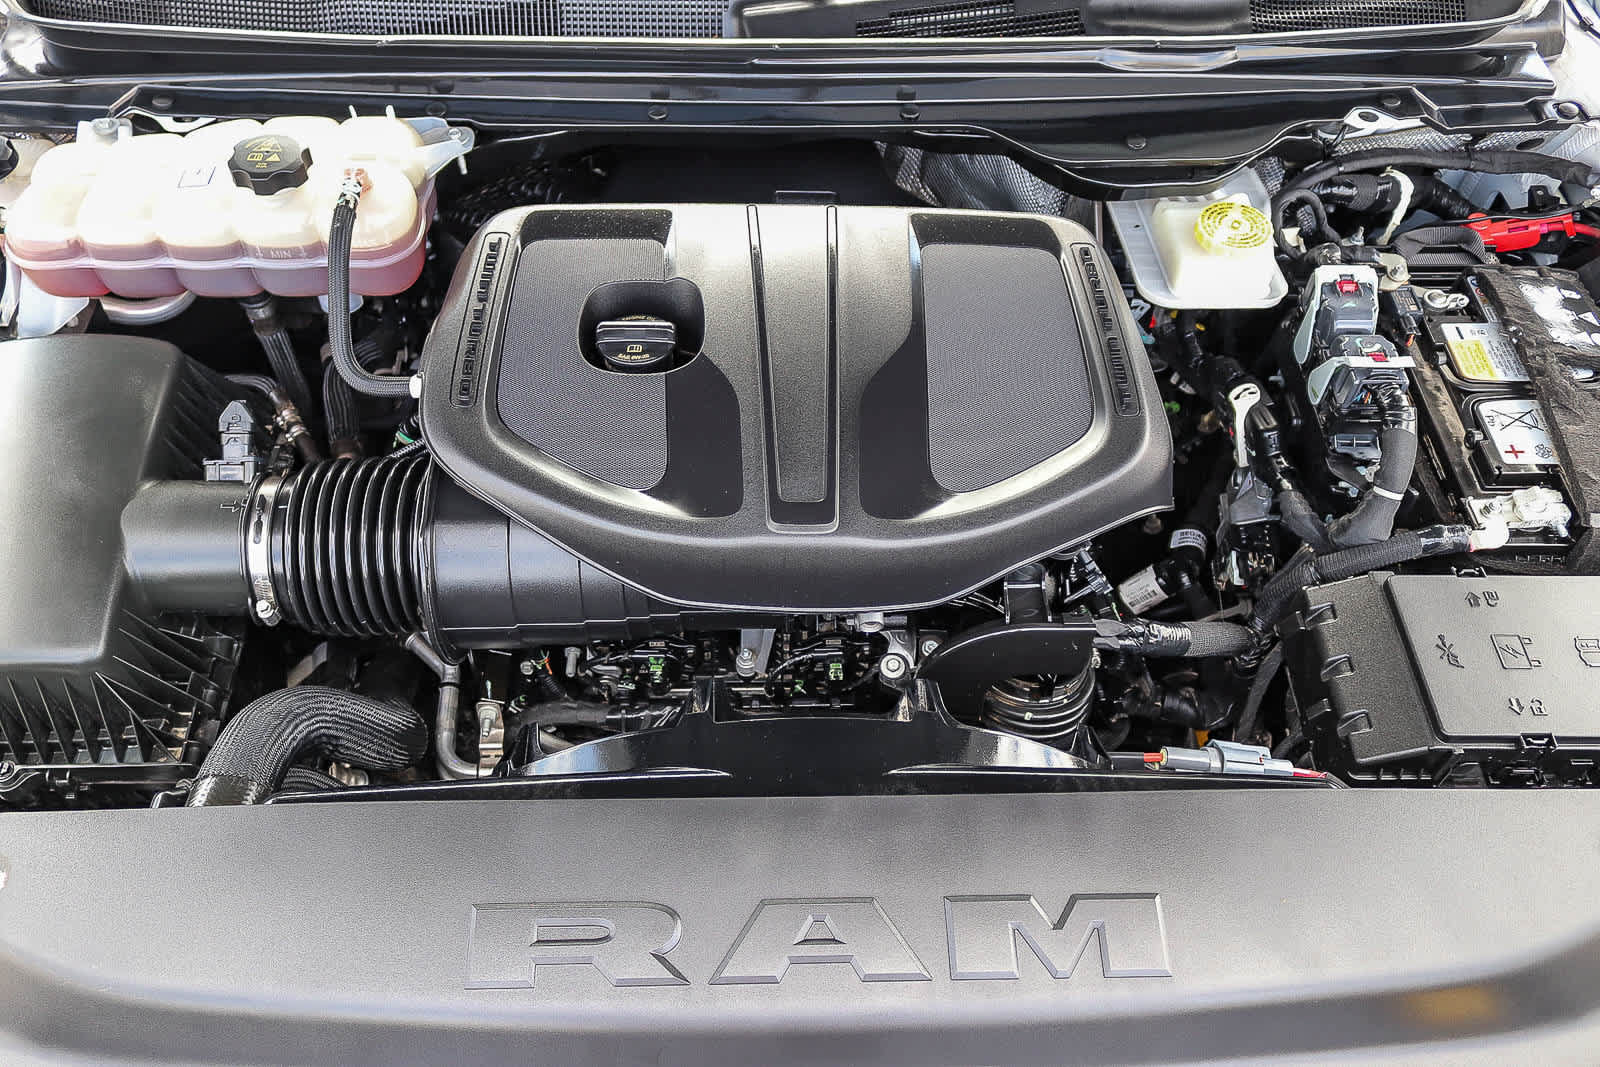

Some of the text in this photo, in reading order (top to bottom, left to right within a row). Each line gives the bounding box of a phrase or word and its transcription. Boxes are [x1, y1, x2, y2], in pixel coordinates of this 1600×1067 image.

[458, 237, 502, 397] TWIN TURBO
[1079, 246, 1113, 332] TURBO
[465, 892, 1172, 989] RAM
